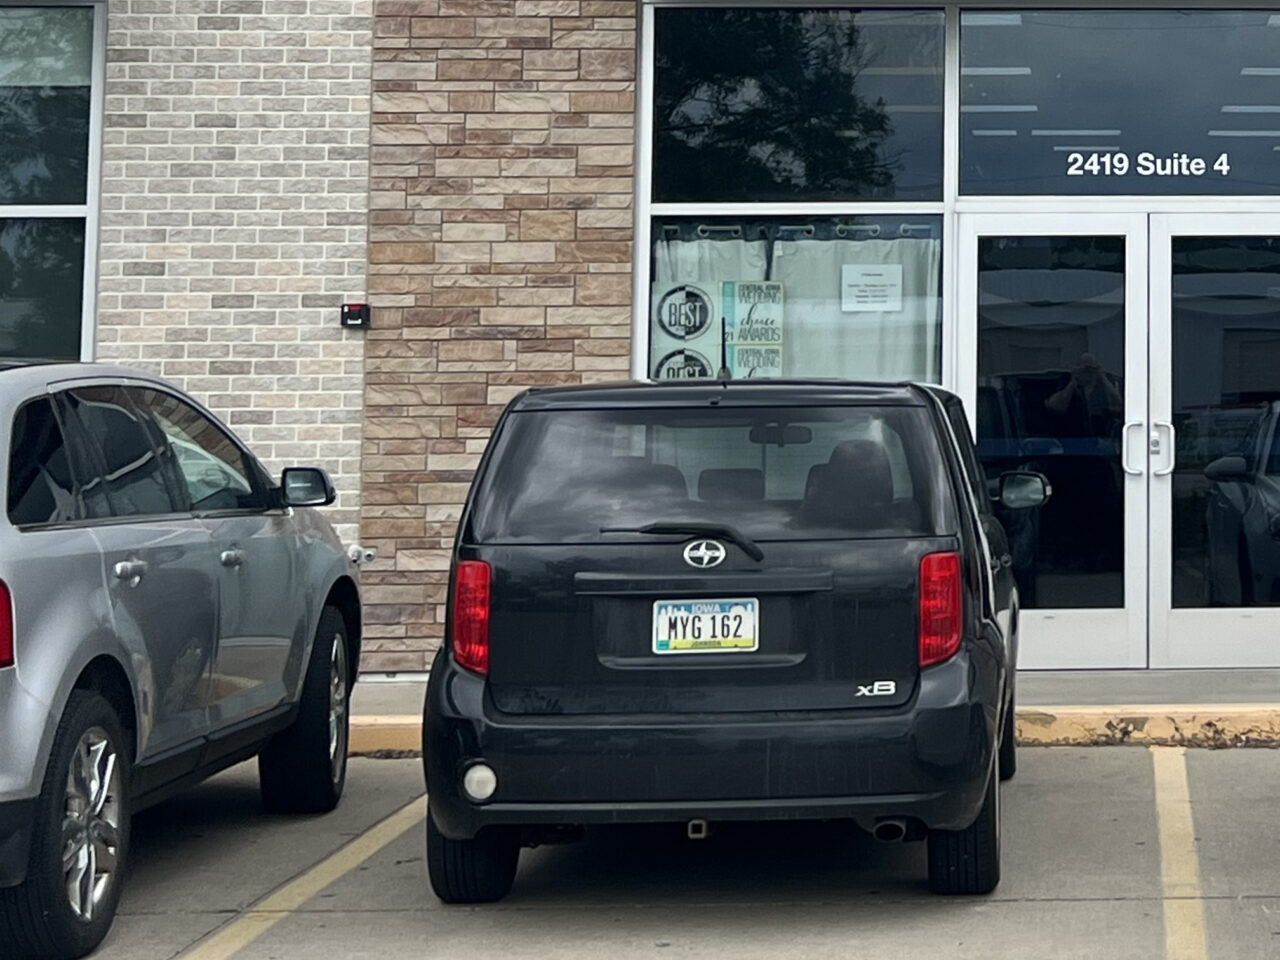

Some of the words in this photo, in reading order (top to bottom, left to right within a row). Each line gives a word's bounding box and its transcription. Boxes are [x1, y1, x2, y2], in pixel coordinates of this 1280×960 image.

[1067, 152, 1129, 176] 2419
[1136, 152, 1206, 176] Suite
[1213, 152, 1230, 176] 4
[668, 302, 703, 328] BEST
[738, 327, 781, 341] AWARDS
[691, 603, 721, 615] IOWA
[668, 615, 702, 640] MYG
[710, 614, 743, 639] 162
[854, 680, 896, 696] xB
